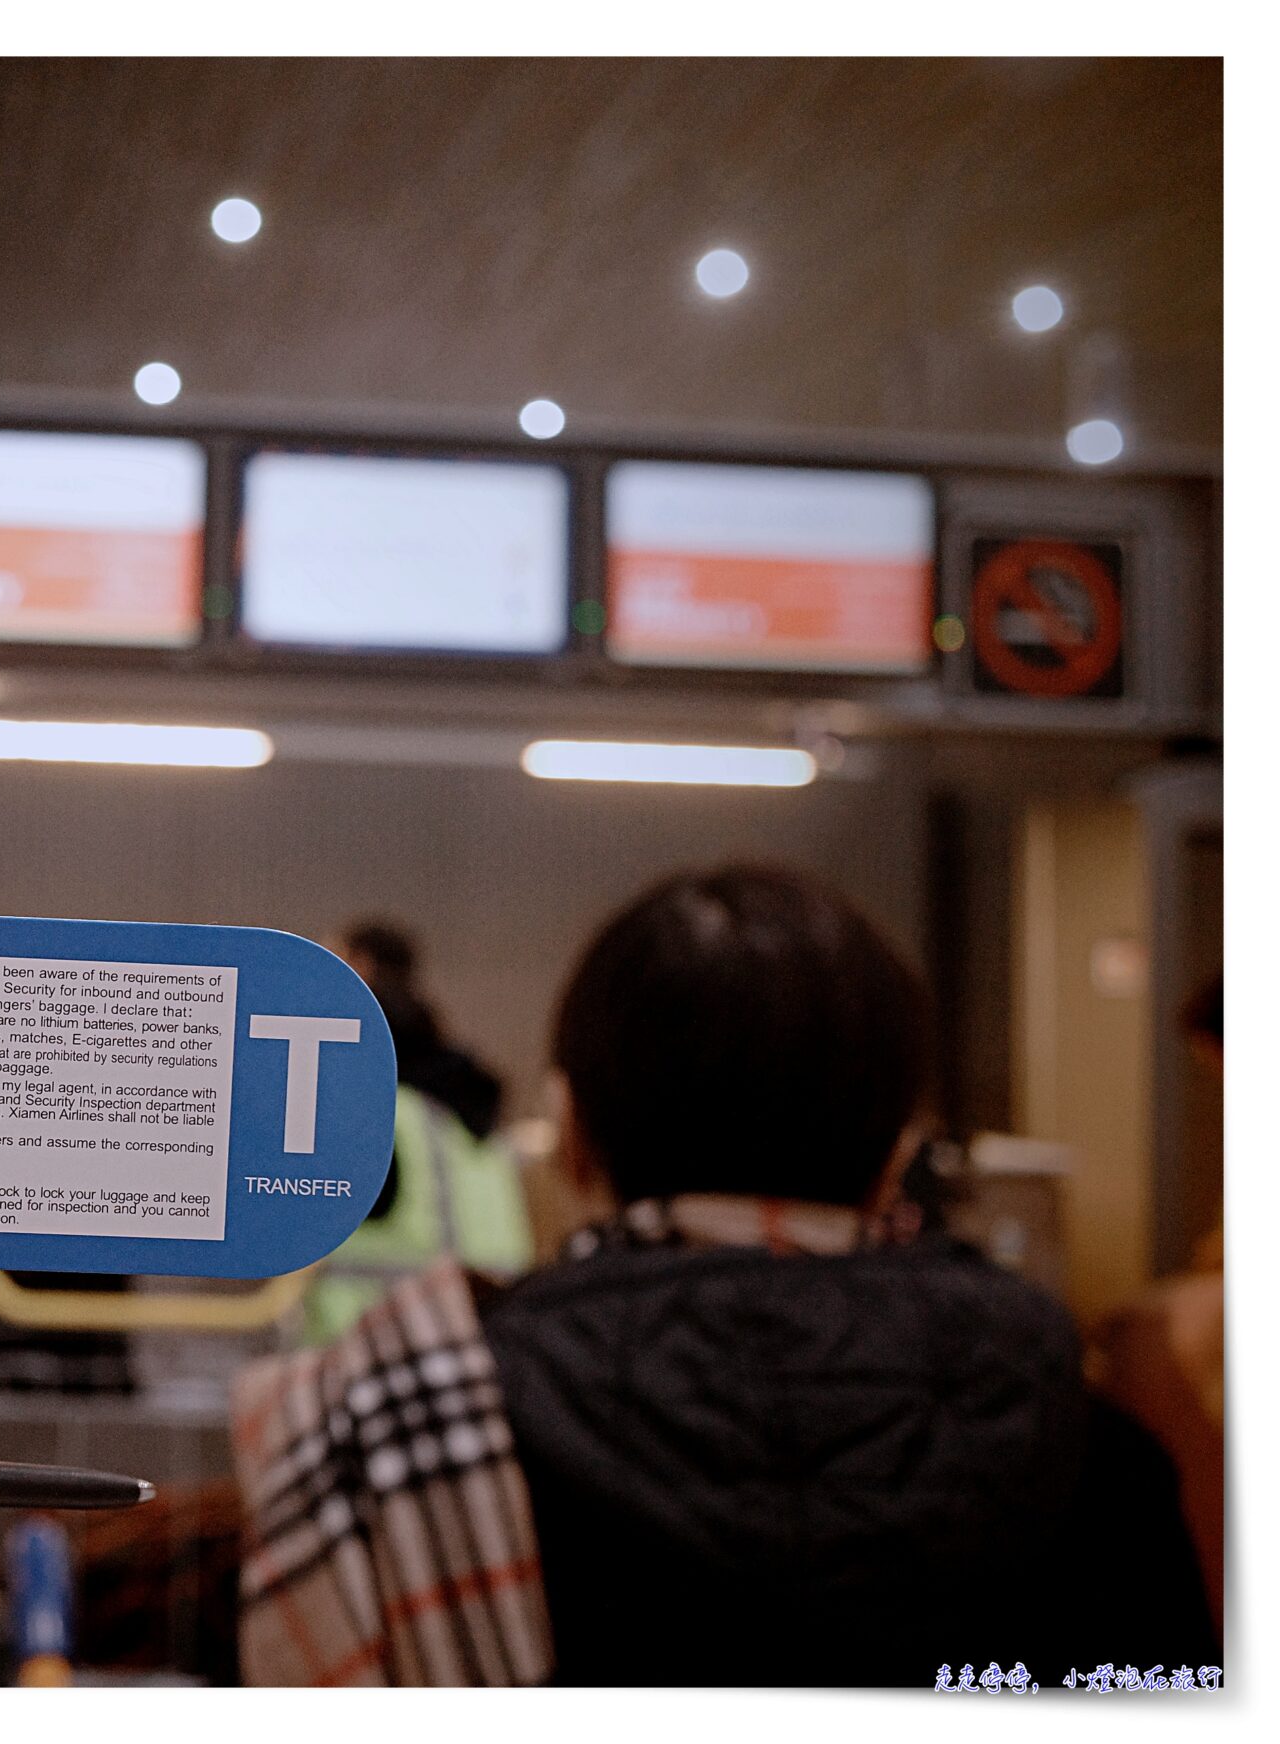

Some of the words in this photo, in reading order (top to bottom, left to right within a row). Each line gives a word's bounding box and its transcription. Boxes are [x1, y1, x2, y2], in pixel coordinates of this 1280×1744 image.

[2, 964, 34, 978] been
[38, 969, 78, 980] aware
[81, 968, 95, 981] of
[98, 969, 119, 982] the
[122, 971, 205, 986] requirements
[208, 974, 222, 987] of
[3, 981, 56, 999] Security
[59, 983, 77, 997] for
[80, 984, 132, 999] inbound
[135, 988, 160, 1000] and
[163, 989, 224, 1003] outbound
[38, 999, 99, 1016] baggage.
[103, 1002, 107, 1014] I
[110, 1002, 159, 1017] declare
[162, 1005, 192, 1018] that:
[20, 1017, 37, 1027] no
[40, 1015, 79, 1029] lithium
[82, 1017, 137, 1033] batteries,
[141, 1022, 180, 1034] power
[182, 1021, 222, 1036] banks,
[9, 1031, 67, 1046] matches,
[71, 1032, 147, 1049] E-cigarettes
[151, 1037, 175, 1049] and
[179, 1038, 213, 1051] other
[12, 1049, 32, 1060] are
[34, 1048, 90, 1063] prohibited
[93, 1050, 108, 1066] by
[110, 1052, 154, 1068] security
[157, 1054, 218, 1069] regulations
[249, 1014, 361, 1154] T
[17, 1135, 42, 1147] and
[46, 1138, 97, 1149] assume
[100, 1137, 121, 1150] the
[124, 1140, 214, 1156] corresponding
[244, 1176, 352, 1197] TRANSFER
